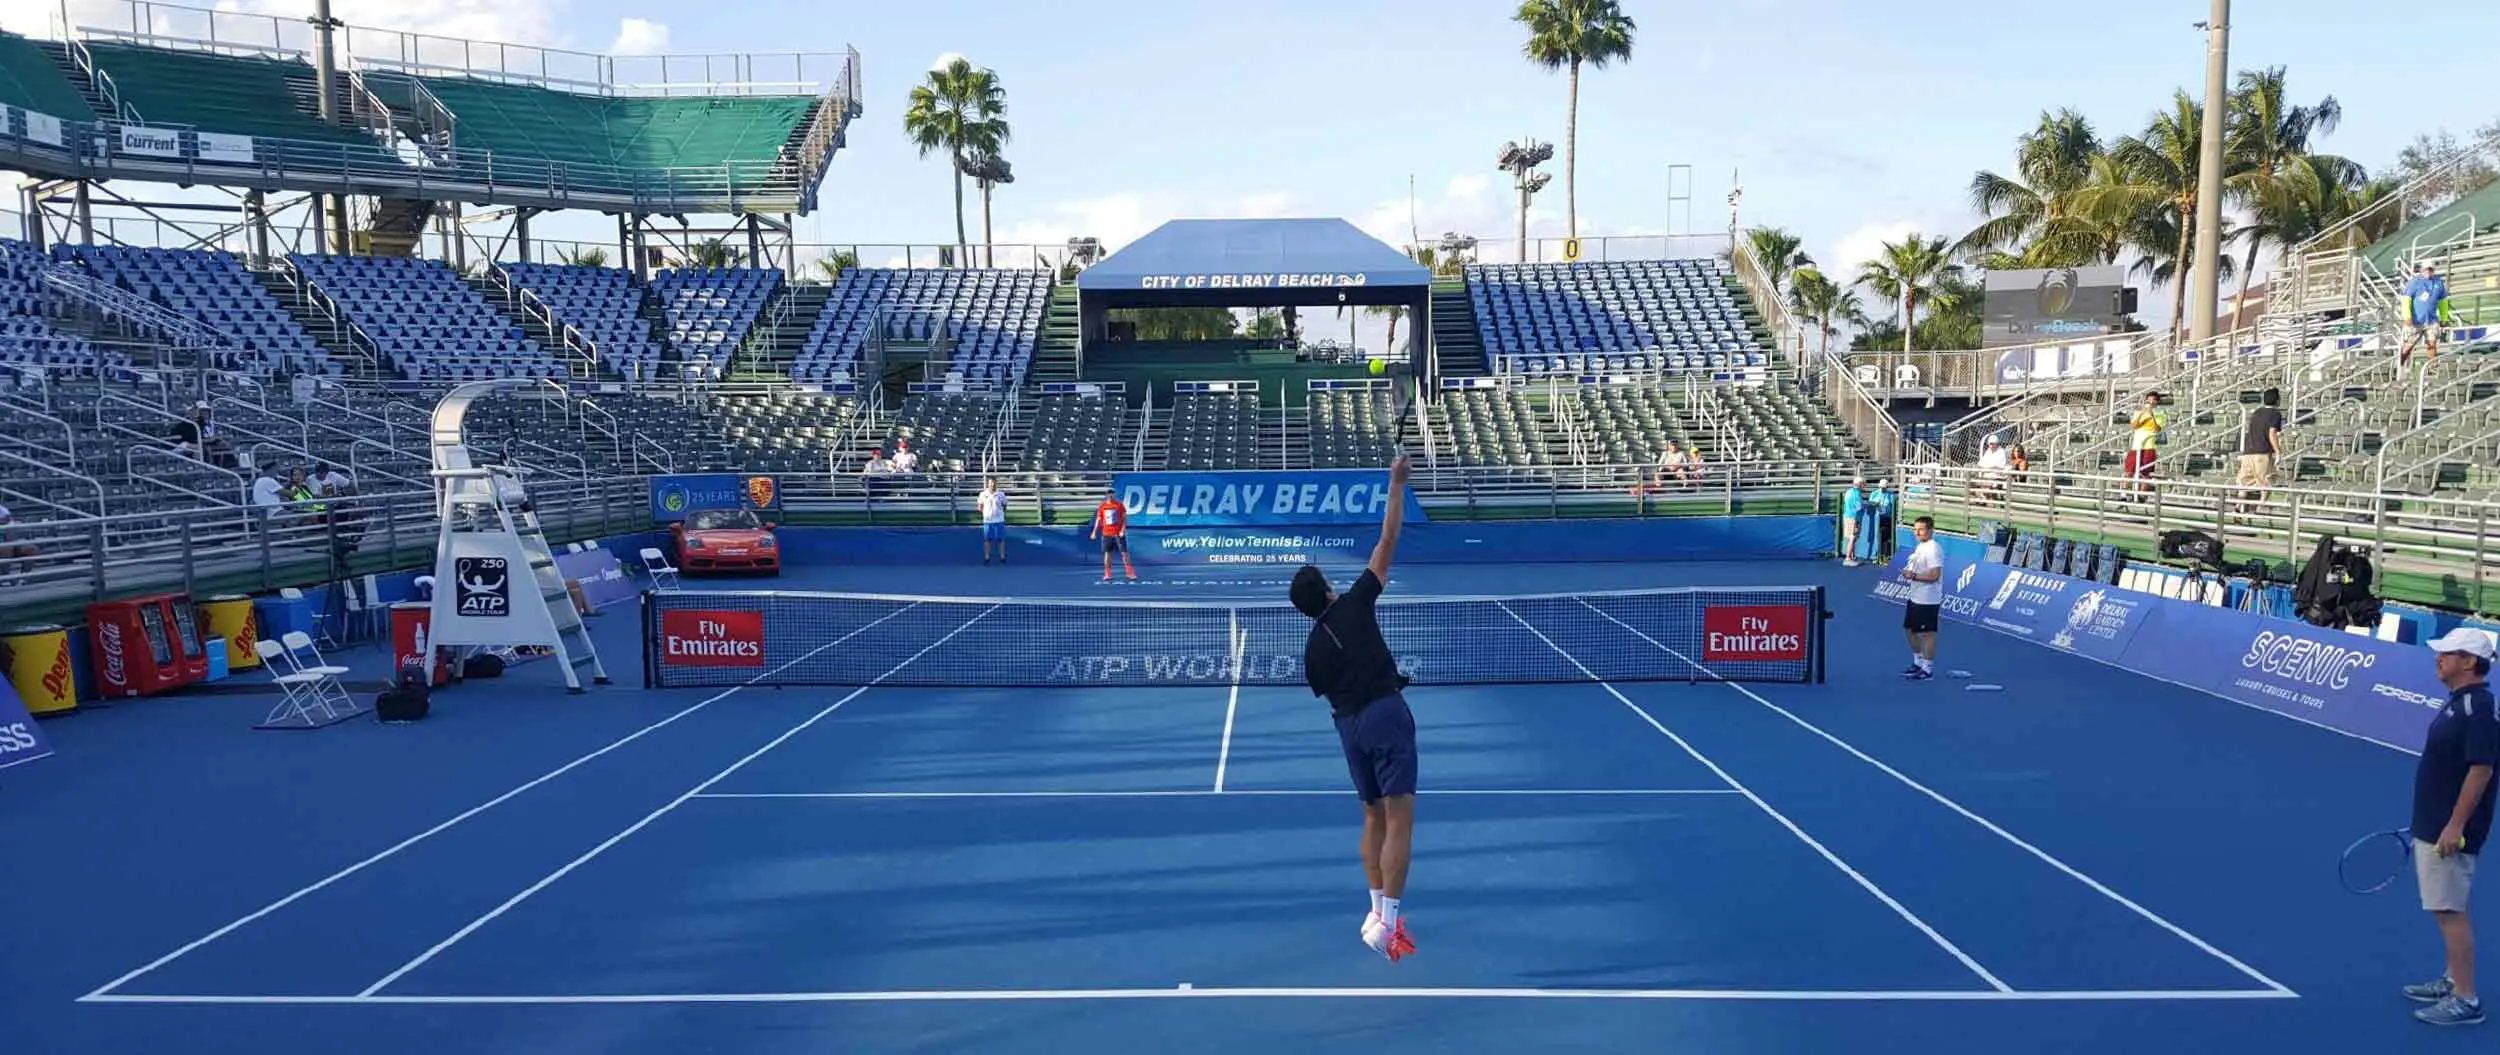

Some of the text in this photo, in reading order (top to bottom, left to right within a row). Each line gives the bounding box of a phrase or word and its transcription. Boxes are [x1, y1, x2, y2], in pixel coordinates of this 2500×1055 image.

[124, 132, 176, 152] Current
[1142, 273, 1333, 289] CITY OF DELRAY BEACH
[1122, 483, 1390, 515] DELRAY BEACH
[480, 559, 505, 569] 250
[1278, 553, 1306, 563] YEARS
[461, 596, 505, 610] ATP
[699, 620, 725, 639] Fly
[1741, 616, 1768, 633] Fly
[667, 635, 759, 657] Emirates
[1709, 631, 1799, 652] Emirates
[1048, 655, 1298, 681] ATP WORLD
[2371, 683, 2445, 709] PORSCHE
